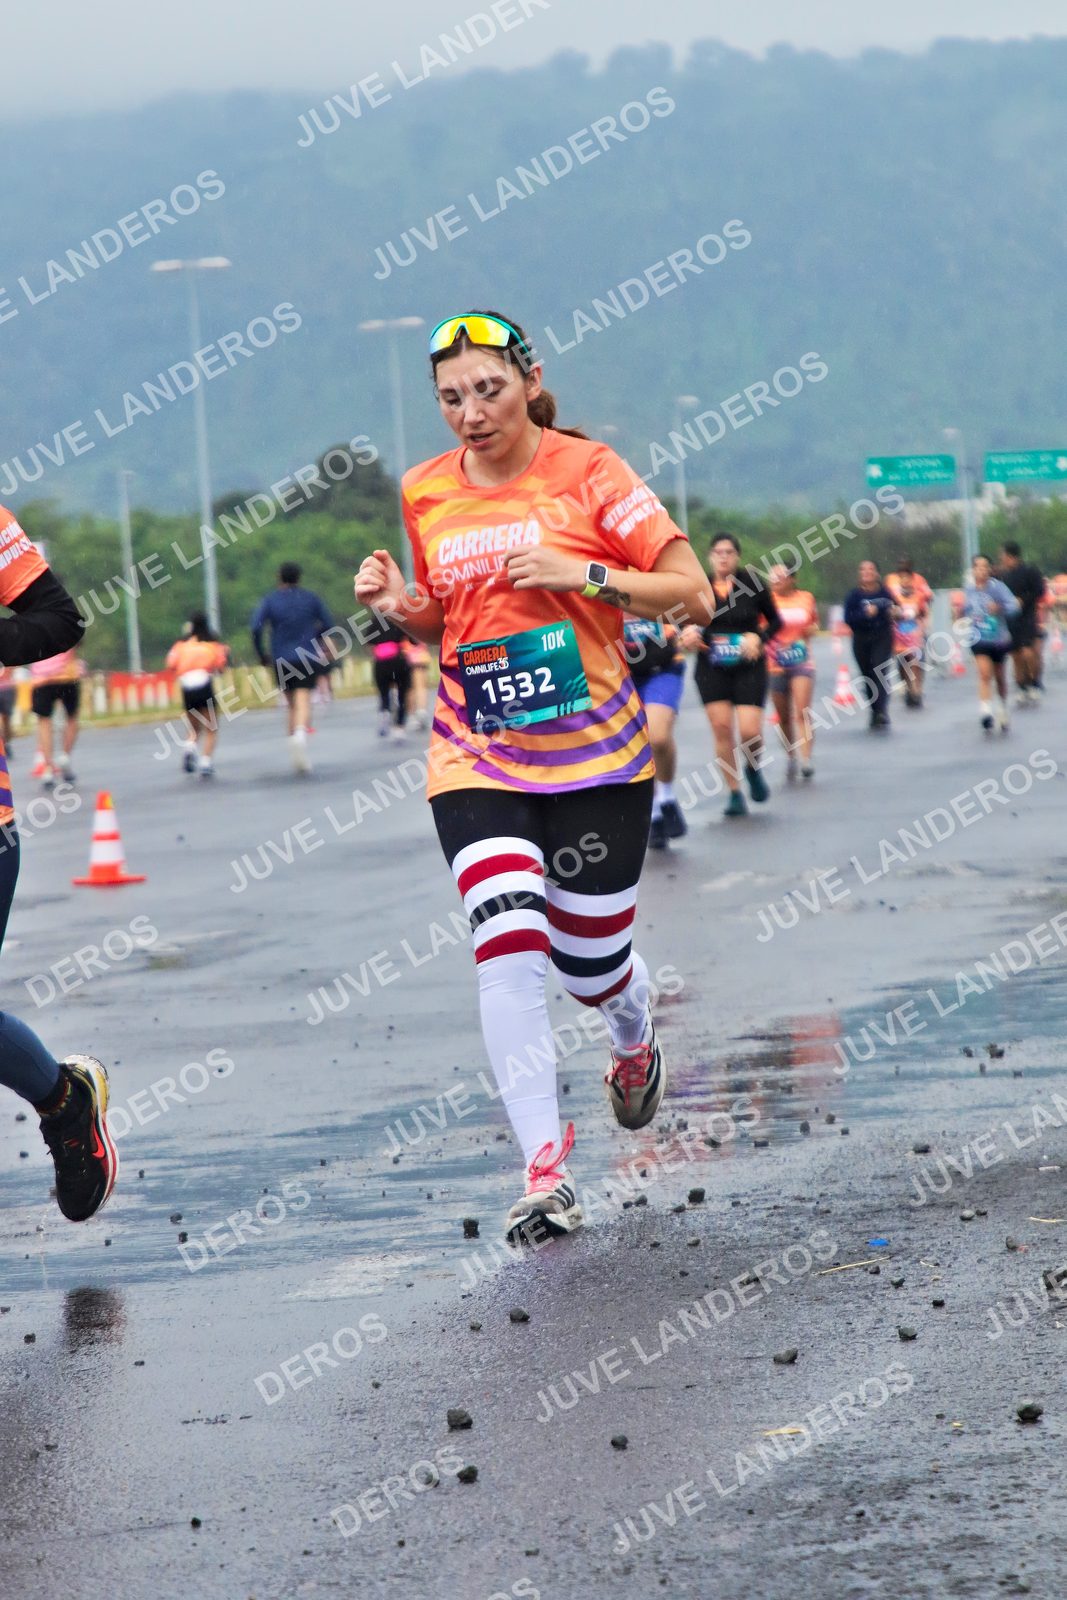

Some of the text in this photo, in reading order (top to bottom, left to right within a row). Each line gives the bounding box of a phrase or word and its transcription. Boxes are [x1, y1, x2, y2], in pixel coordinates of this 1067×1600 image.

[438, 519, 540, 565] CARRERA
[442, 554, 505, 585] OMNILIF
[463, 645, 508, 666] CARRERA
[541, 628, 566, 652] 10K
[481, 666, 556, 704] 1532
